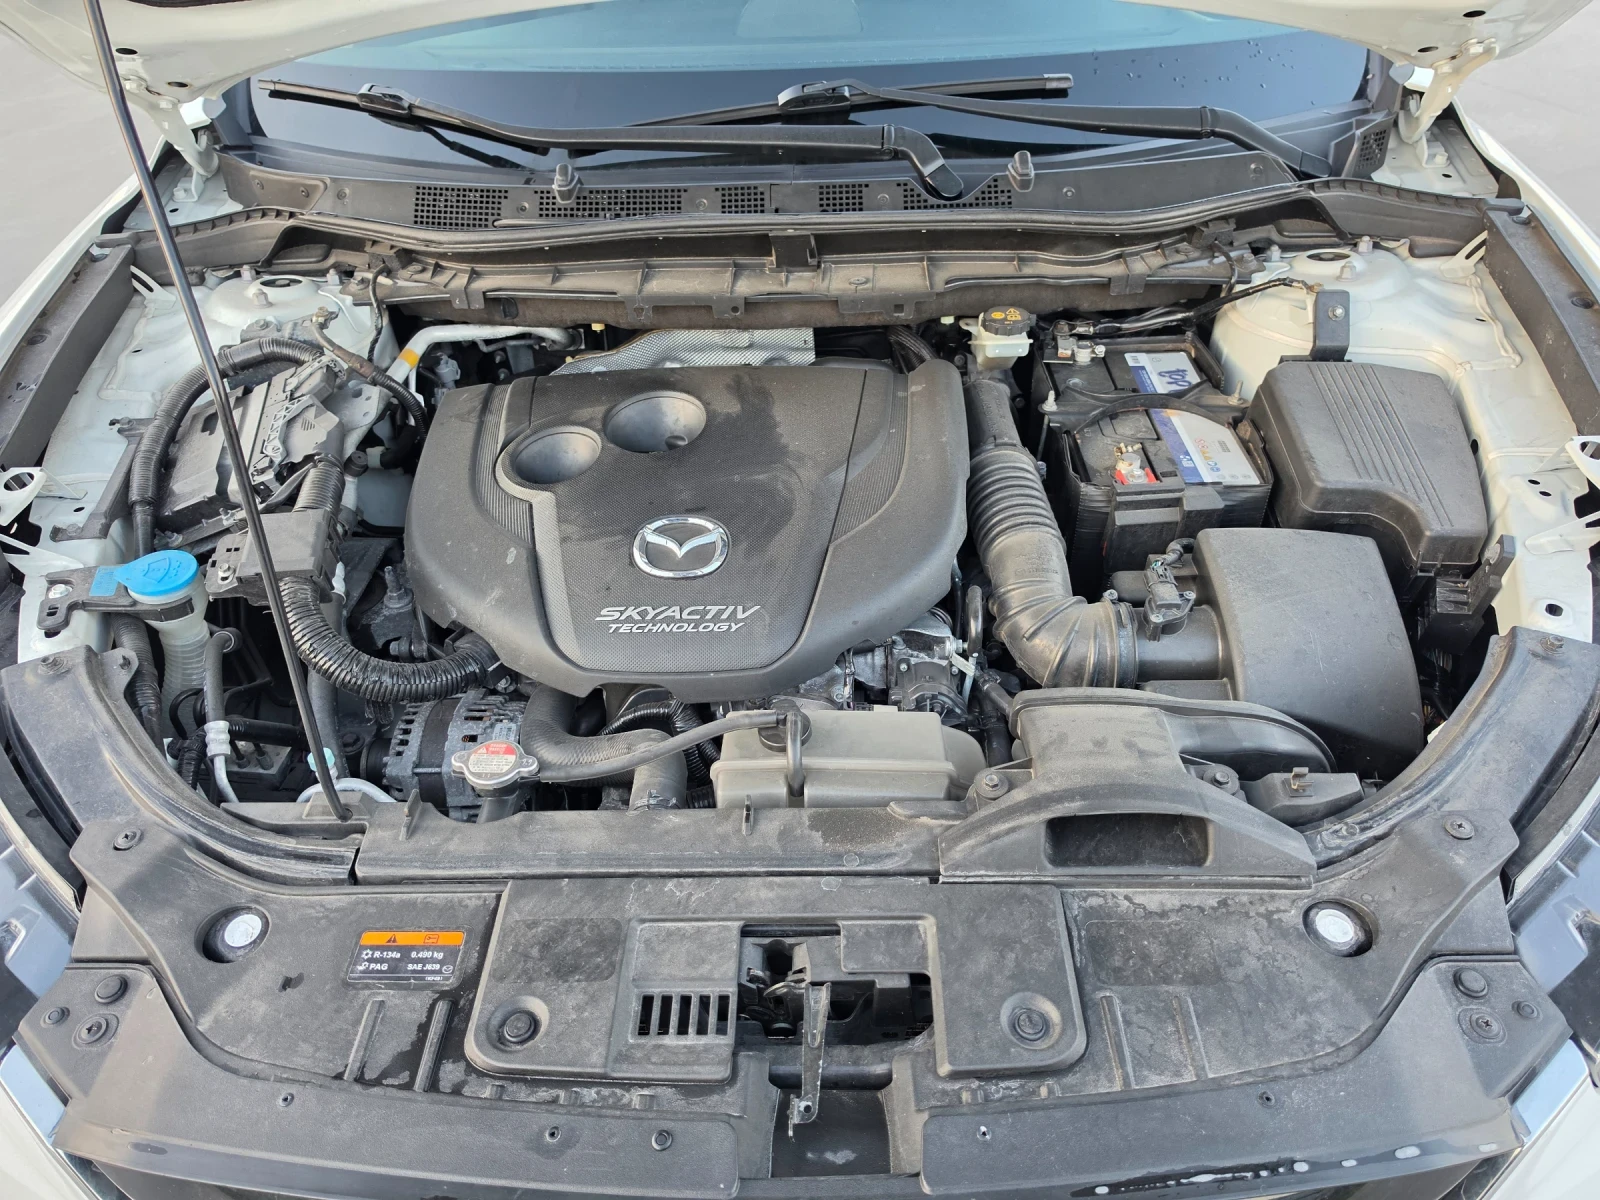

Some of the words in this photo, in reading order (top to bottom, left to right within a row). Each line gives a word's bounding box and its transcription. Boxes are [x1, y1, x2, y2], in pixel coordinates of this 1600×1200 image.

[595, 606, 761, 621] SKYACTIV
[608, 622, 745, 634] TECHNOLOGY
[433, 951, 444, 959] kg
